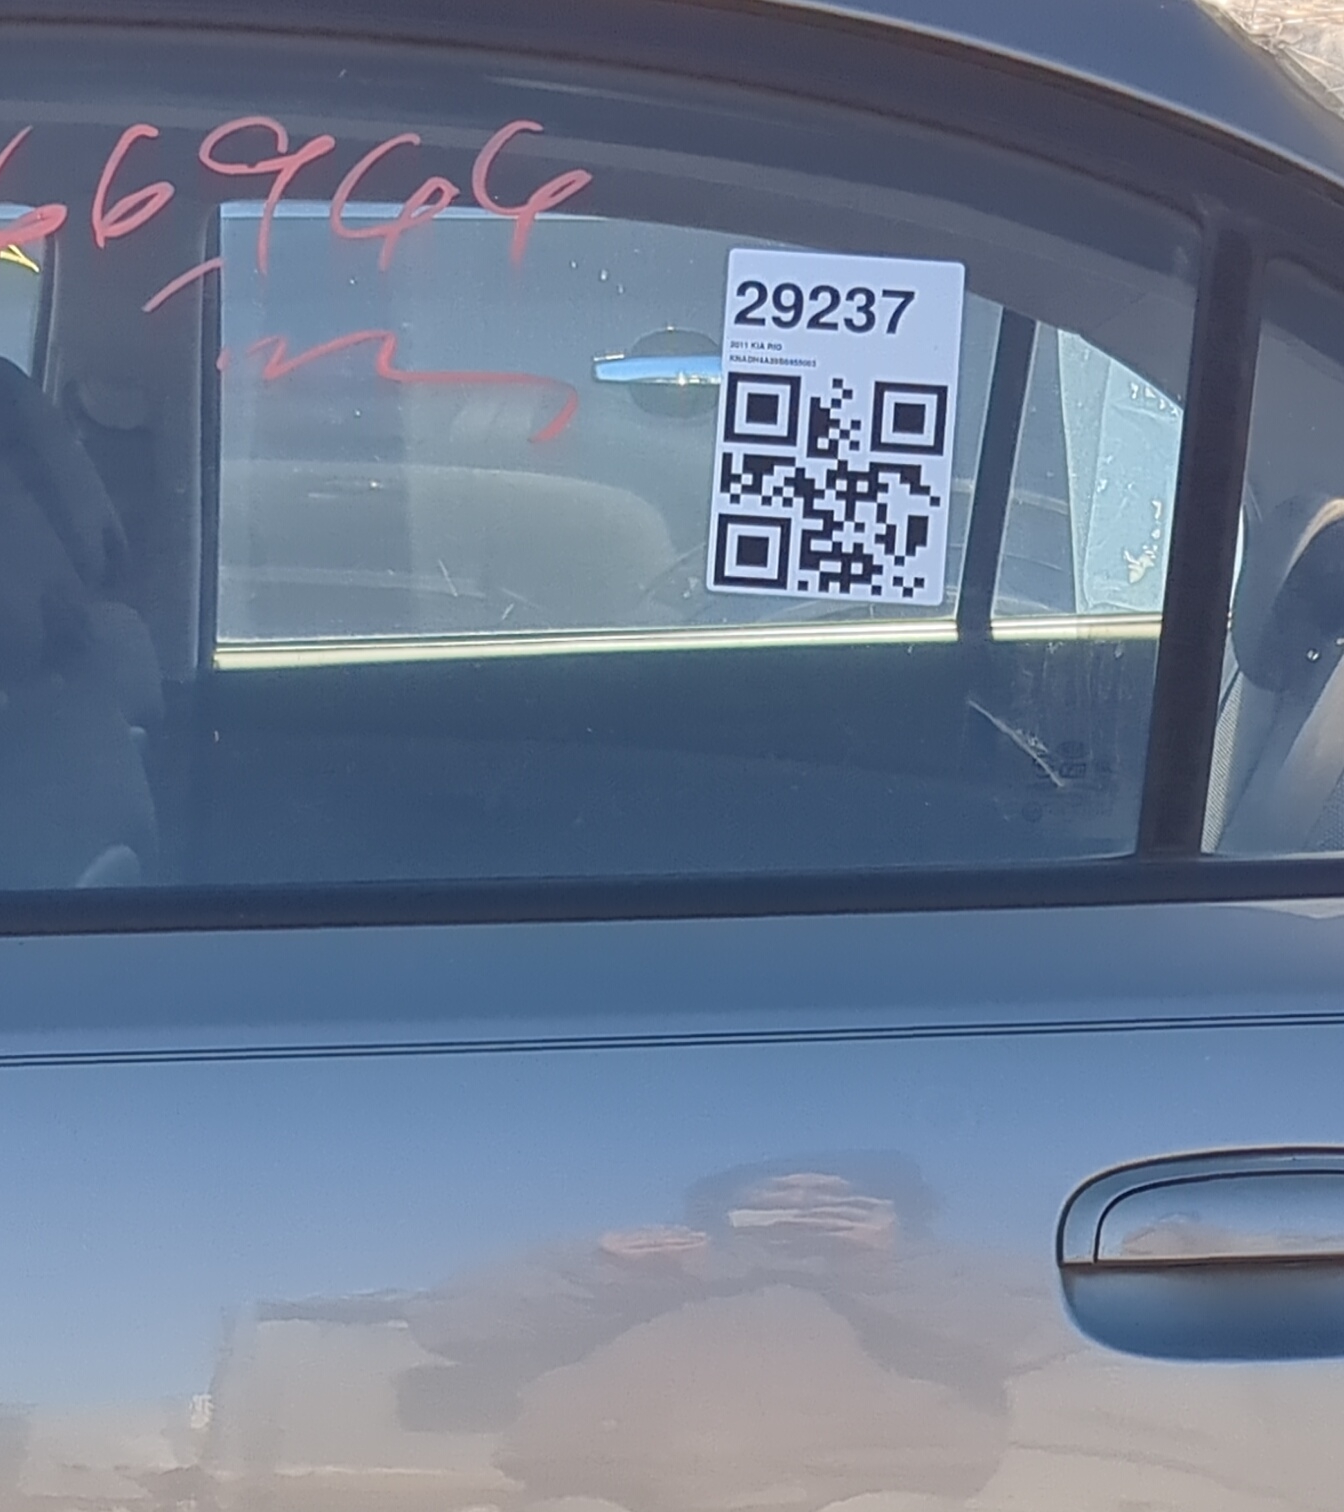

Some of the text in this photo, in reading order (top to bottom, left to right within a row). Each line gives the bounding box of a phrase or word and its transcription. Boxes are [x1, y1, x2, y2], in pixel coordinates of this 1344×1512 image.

[734, 280, 916, 335] 29237
[730, 341, 783, 351] 2011 KIA RIO
